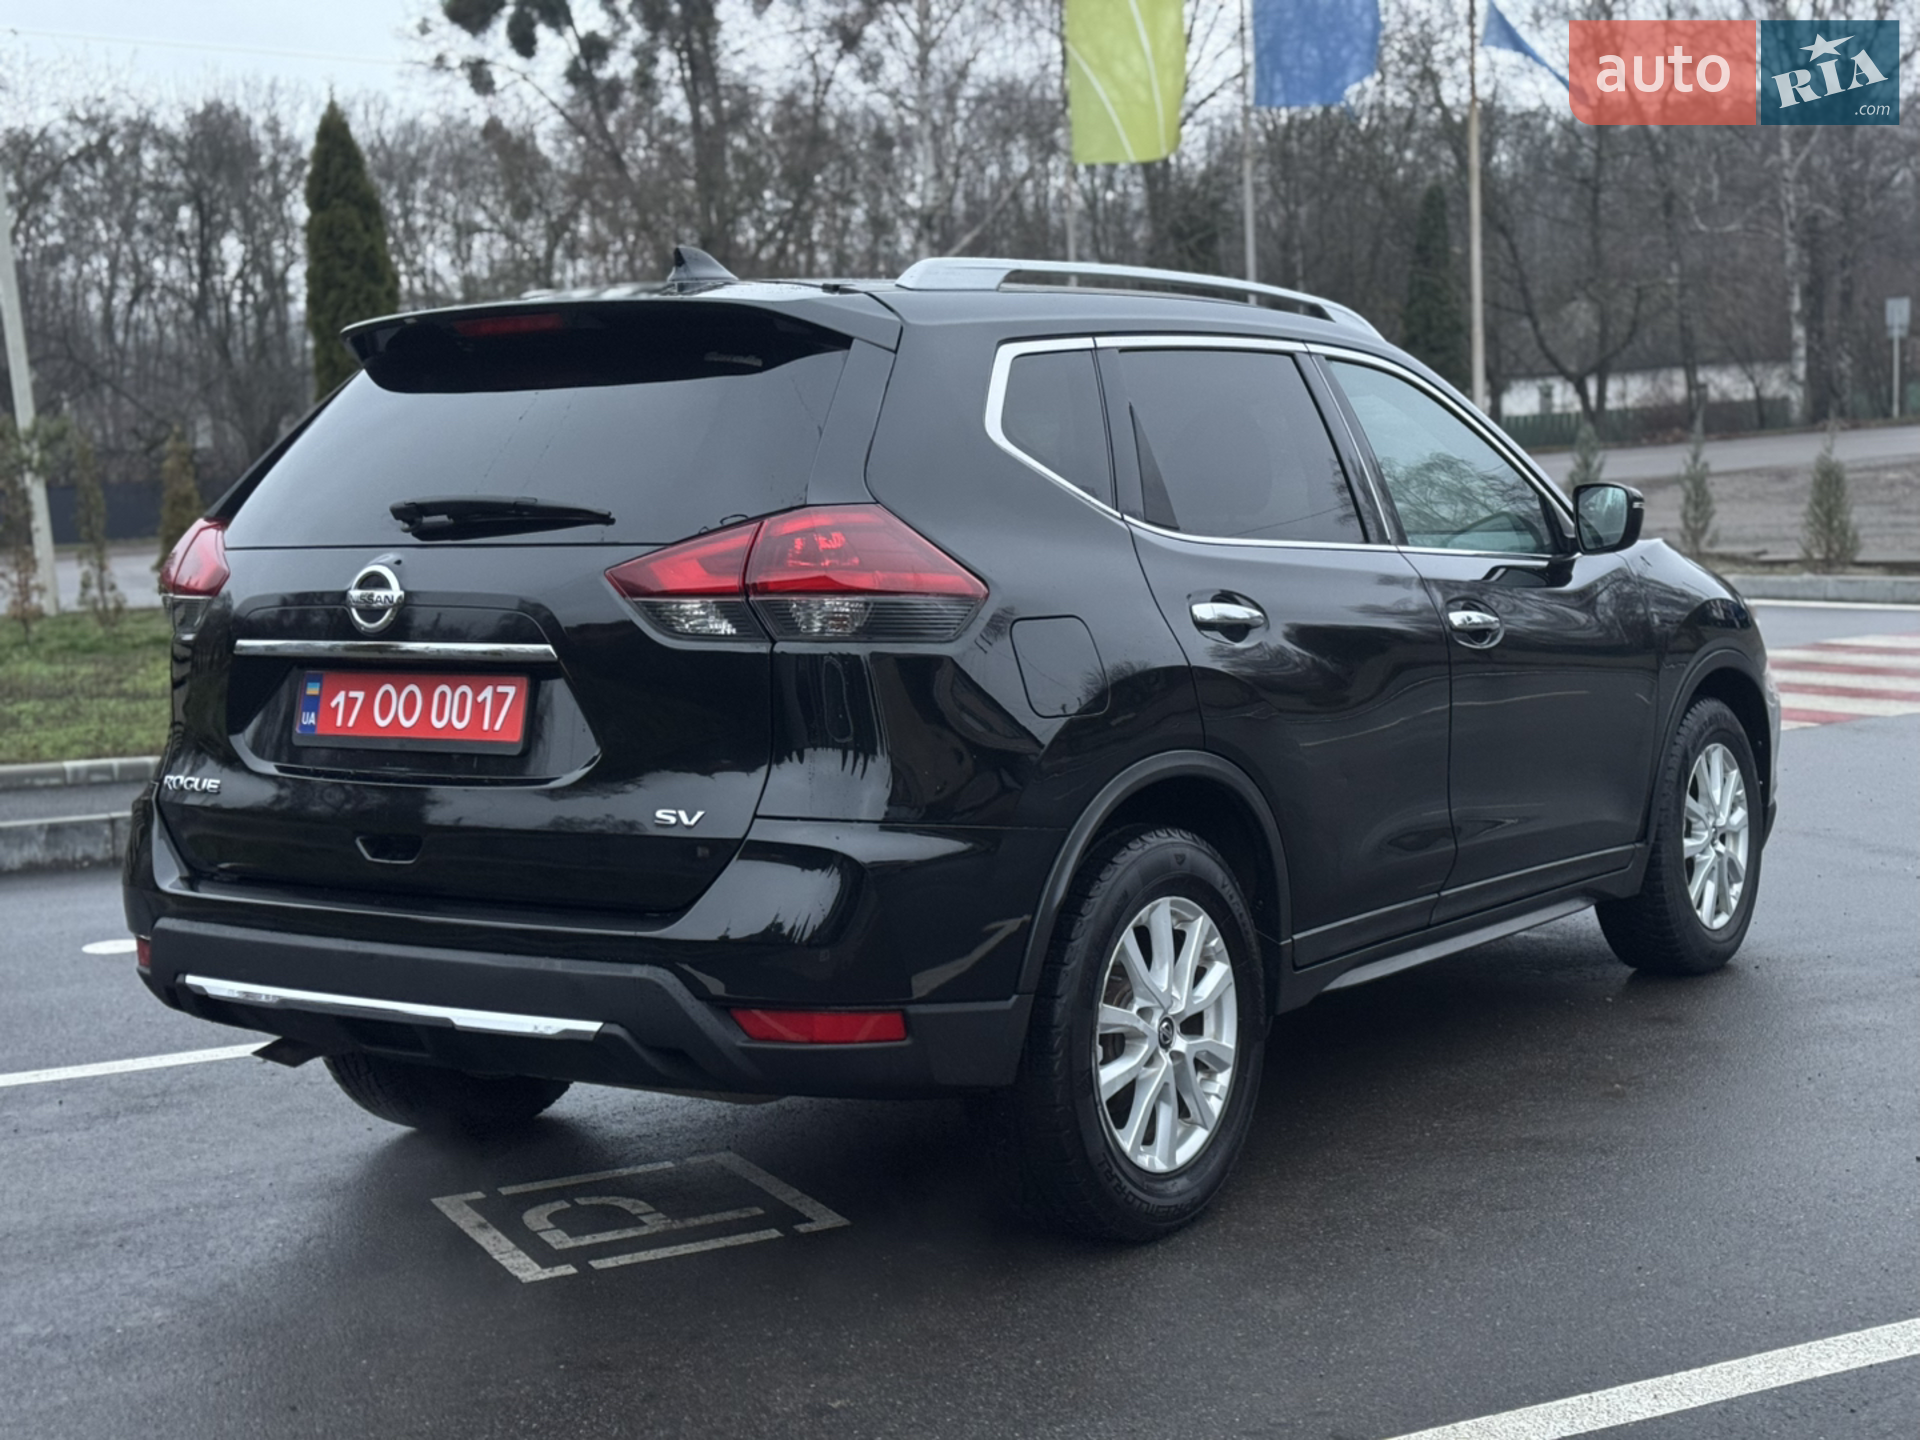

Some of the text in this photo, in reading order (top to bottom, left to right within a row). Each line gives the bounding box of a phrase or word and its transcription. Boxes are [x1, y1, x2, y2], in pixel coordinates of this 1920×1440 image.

[350, 592, 394, 605] NISSAN
[330, 691, 365, 727] 17
[430, 684, 517, 731] 0017
[302, 711, 316, 725] UA
[163, 774, 220, 793] ROGUE
[654, 809, 705, 827] SV
